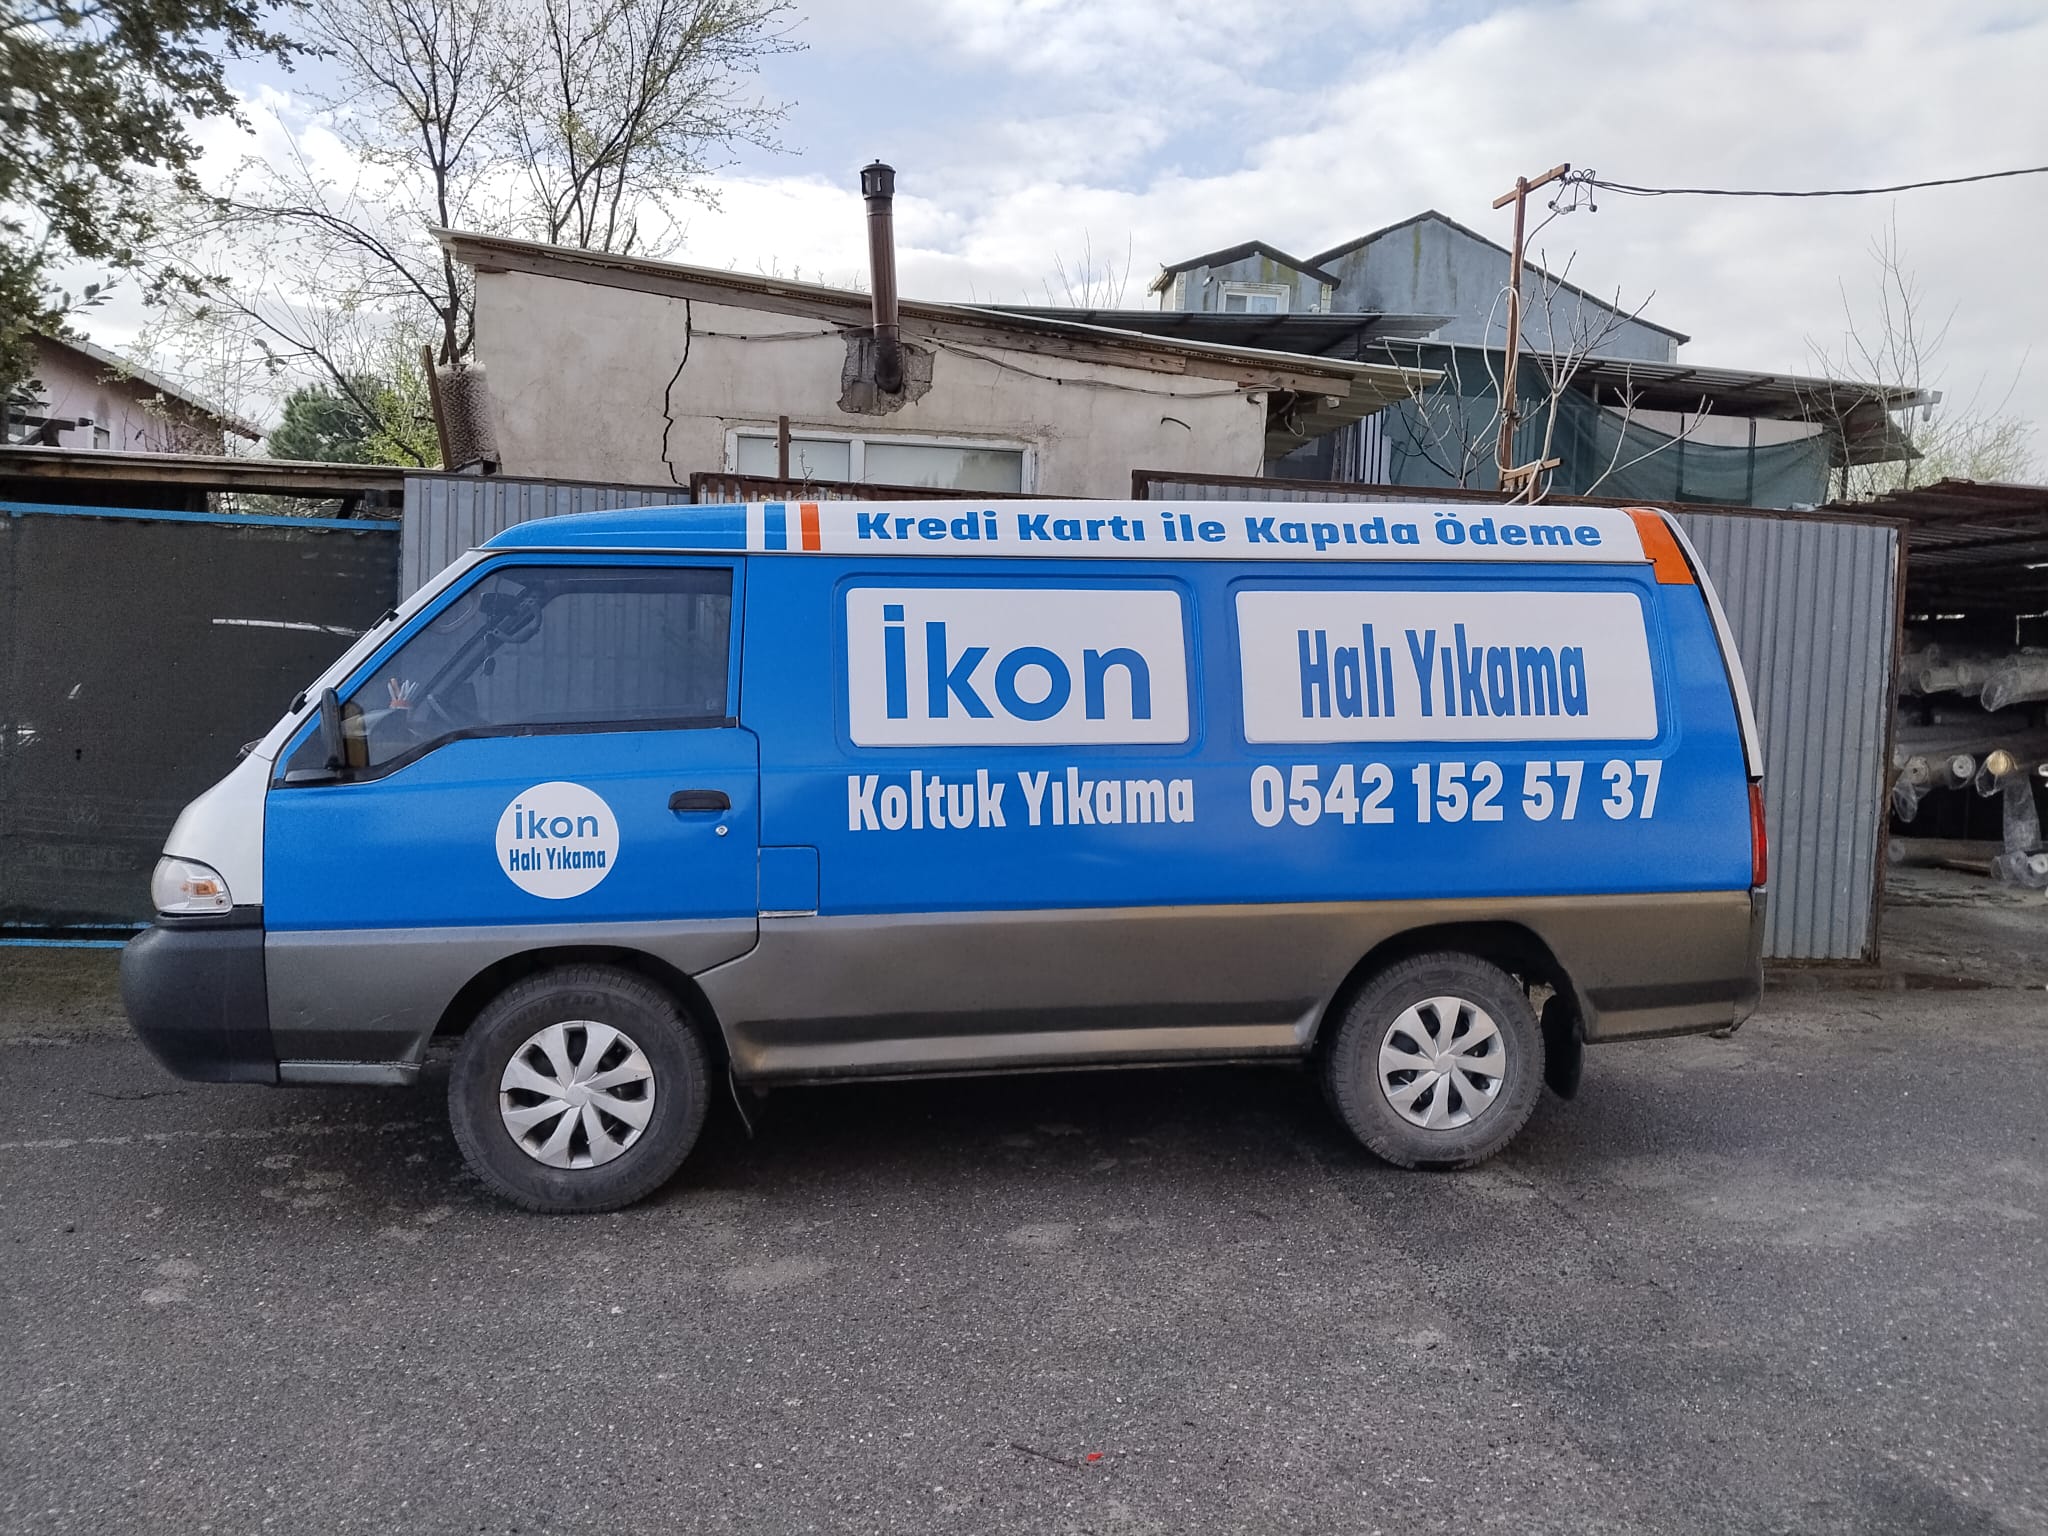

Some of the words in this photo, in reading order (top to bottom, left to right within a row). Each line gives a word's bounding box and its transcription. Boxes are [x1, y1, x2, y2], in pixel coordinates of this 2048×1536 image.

[856, 510, 999, 541] Kredi
[1017, 513, 1146, 542] Kartı
[1160, 511, 1226, 543] ile
[1244, 516, 1420, 552] Kapıda
[1434, 511, 1602, 547] Ödeme
[1297, 623, 1396, 719] Halı
[1404, 623, 1589, 718] Yıkama
[847, 768, 1007, 831] Koltuk
[1017, 766, 1195, 826] Yıkama
[1250, 762, 1395, 828] 0542
[1411, 760, 1504, 823] 152
[1522, 760, 1585, 822] 57
[1601, 759, 1663, 820] 37
[509, 846, 541, 872] Halı
[545, 845, 606, 870] Yıkama
